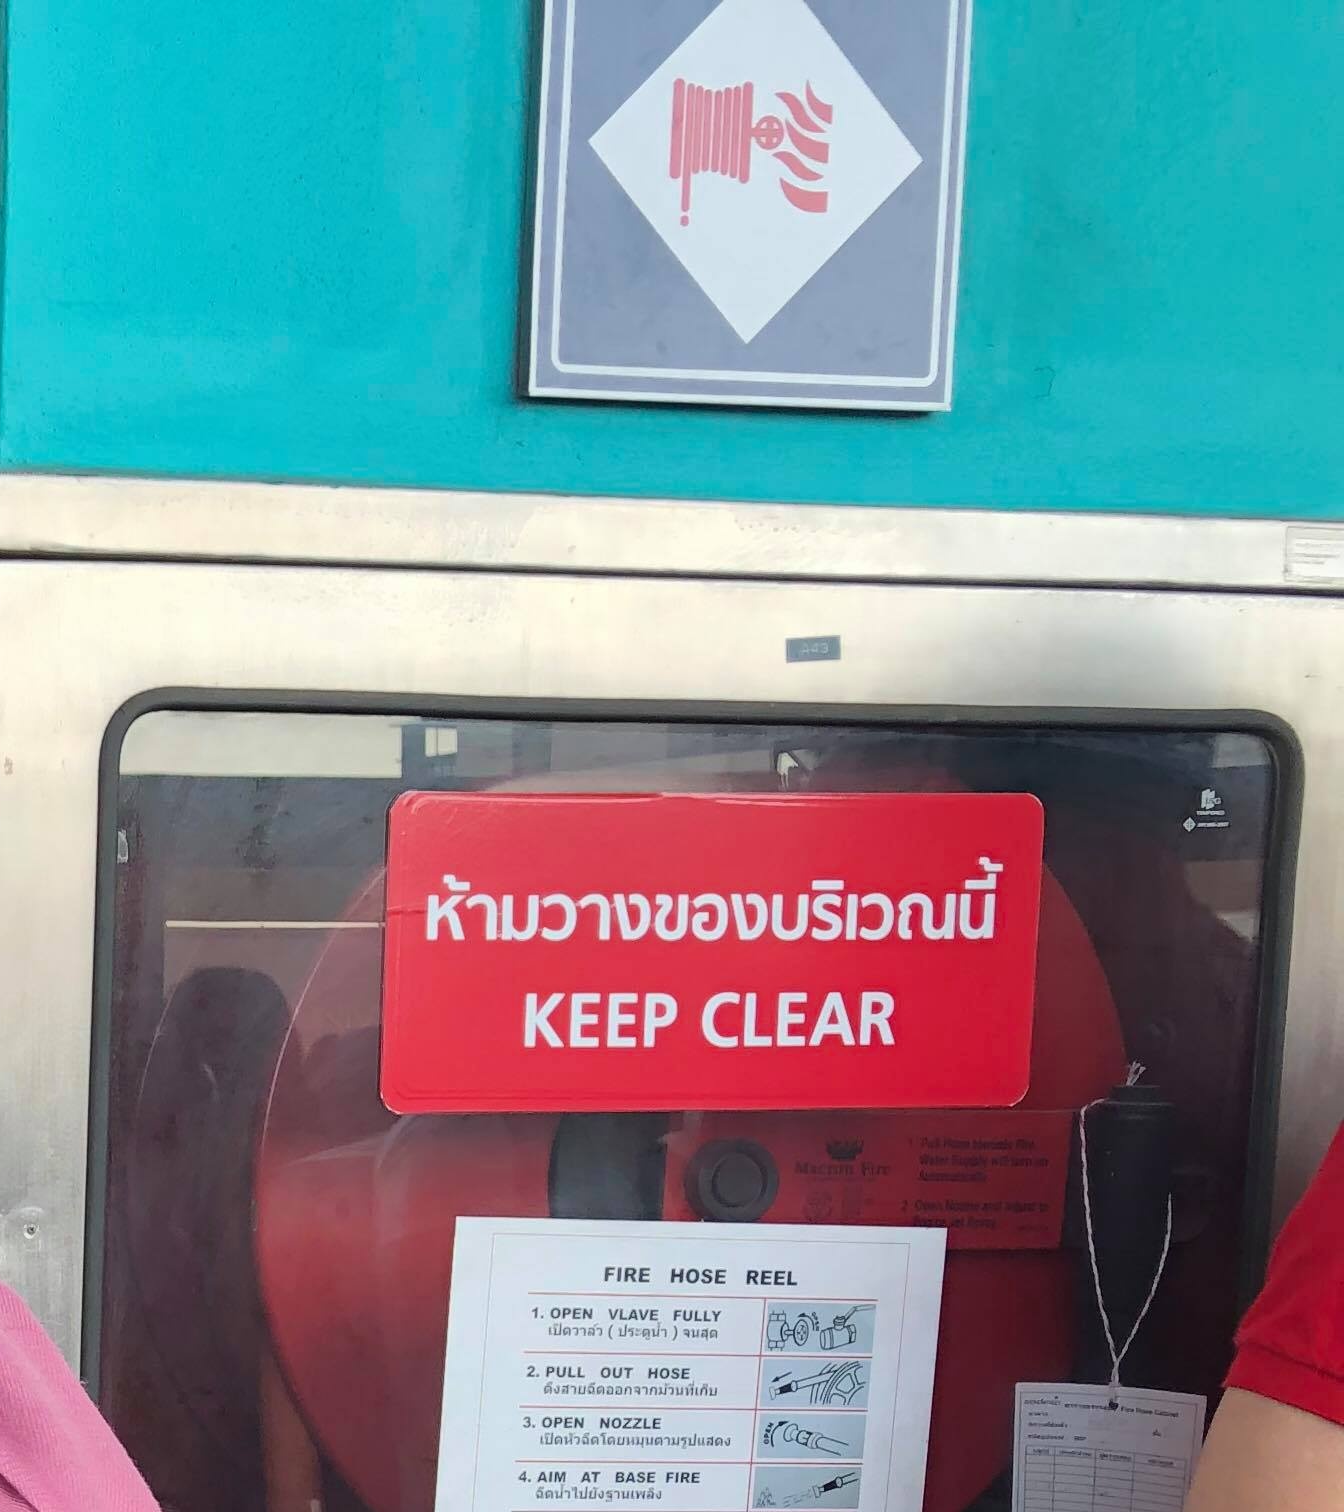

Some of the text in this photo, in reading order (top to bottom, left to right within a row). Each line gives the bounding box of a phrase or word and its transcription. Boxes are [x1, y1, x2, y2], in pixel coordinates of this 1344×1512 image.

[425, 857, 1004, 942] ห้ามวางของบริเวณนี้
[523, 991, 895, 1049] KEEP CLEAR
[603, 1266, 798, 1287] FIRE HOSE REEL
[531, 1307, 722, 1322] 1. OPEN VLAVE FULLY
[526, 1364, 691, 1380] 2. PULL OUT HOSE
[522, 1416, 662, 1430] 3. OPEN NOZZLE
[518, 1470, 700, 1485] 4. AIM AT BASE FIRE
